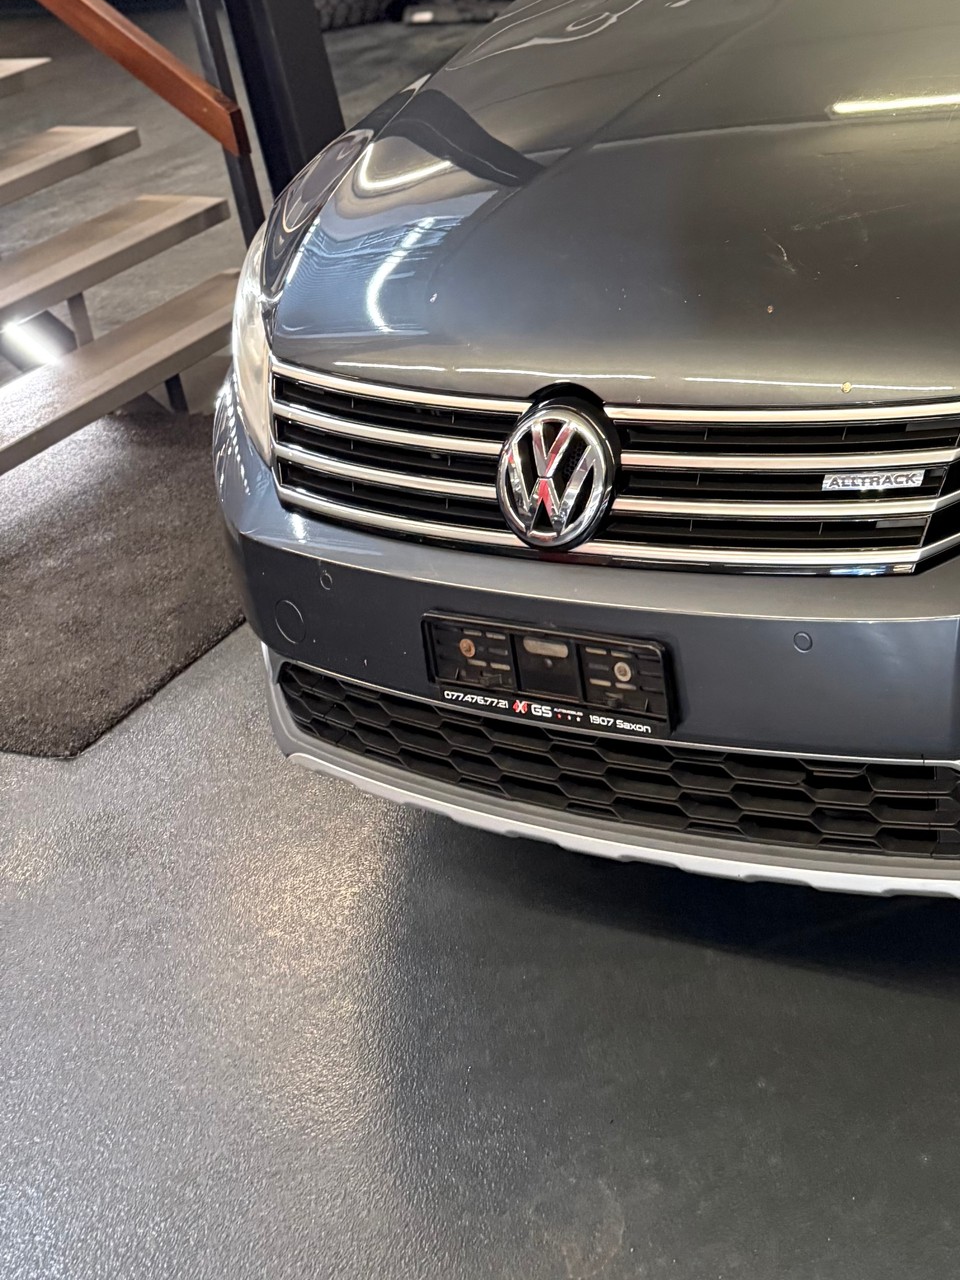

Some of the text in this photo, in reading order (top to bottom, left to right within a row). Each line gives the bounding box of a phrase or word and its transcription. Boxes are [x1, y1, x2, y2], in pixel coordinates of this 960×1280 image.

[506, 415, 604, 538] VW
[828, 472, 917, 489] ALLTRACK
[530, 704, 553, 718] GS
[589, 715, 614, 727] 1907
[616, 720, 652, 733] Saxon
